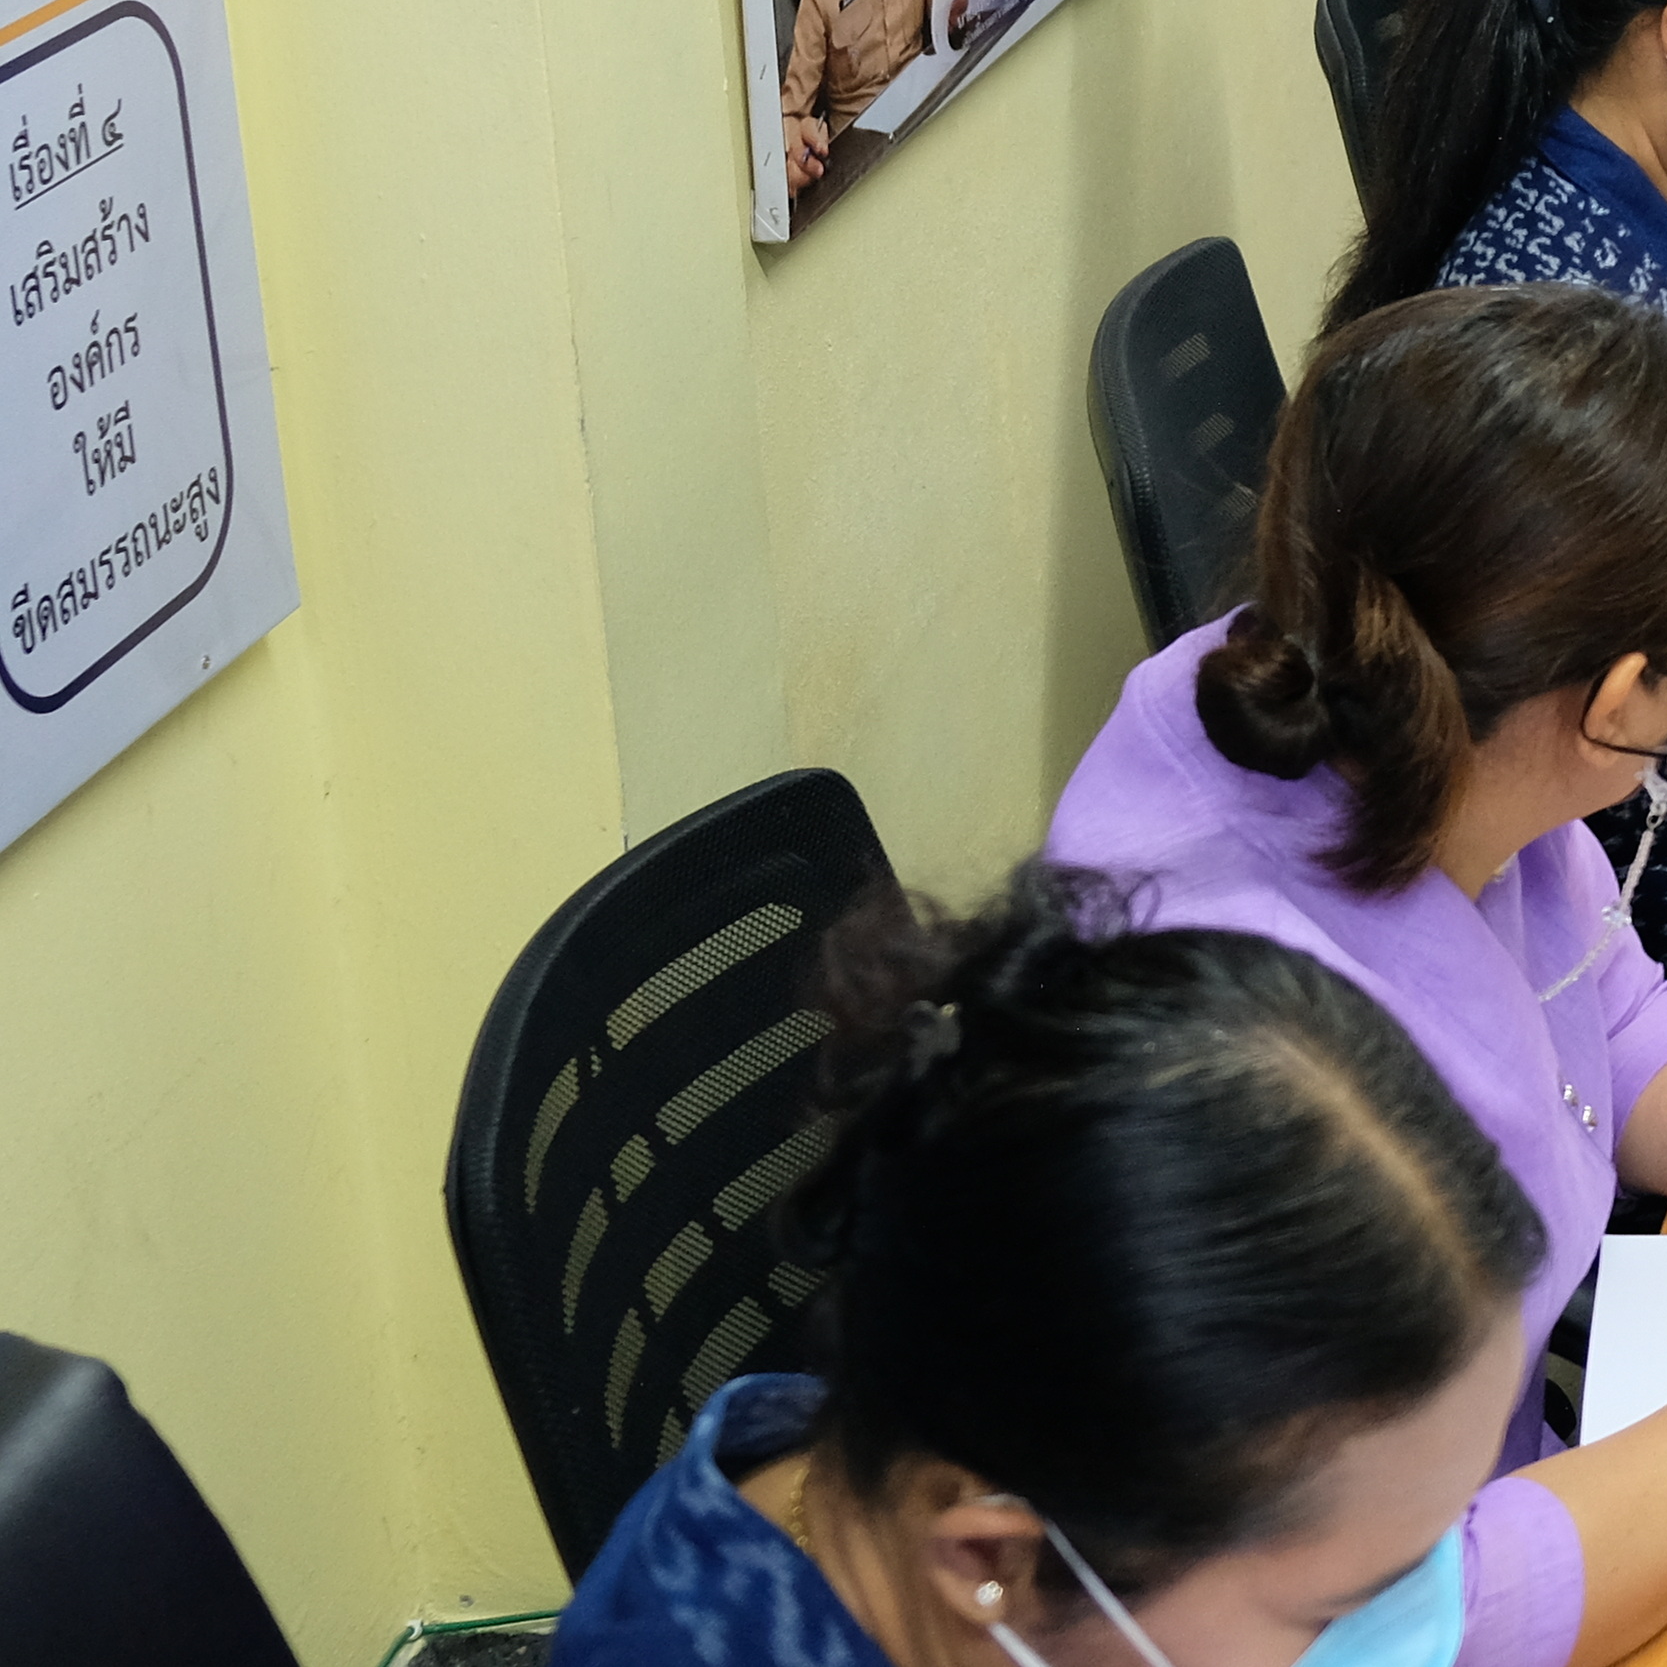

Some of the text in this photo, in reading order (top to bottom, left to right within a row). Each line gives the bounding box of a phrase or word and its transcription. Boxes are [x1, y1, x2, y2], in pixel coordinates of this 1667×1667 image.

[10, 84, 92, 201] เรื่องที่
[10, 196, 152, 328] เสริมสร้าง
[48, 309, 142, 411] องค์กร
[74, 399, 137, 498] ให้มี
[11, 464, 221, 657] ขีดสมรรถนะสูง
